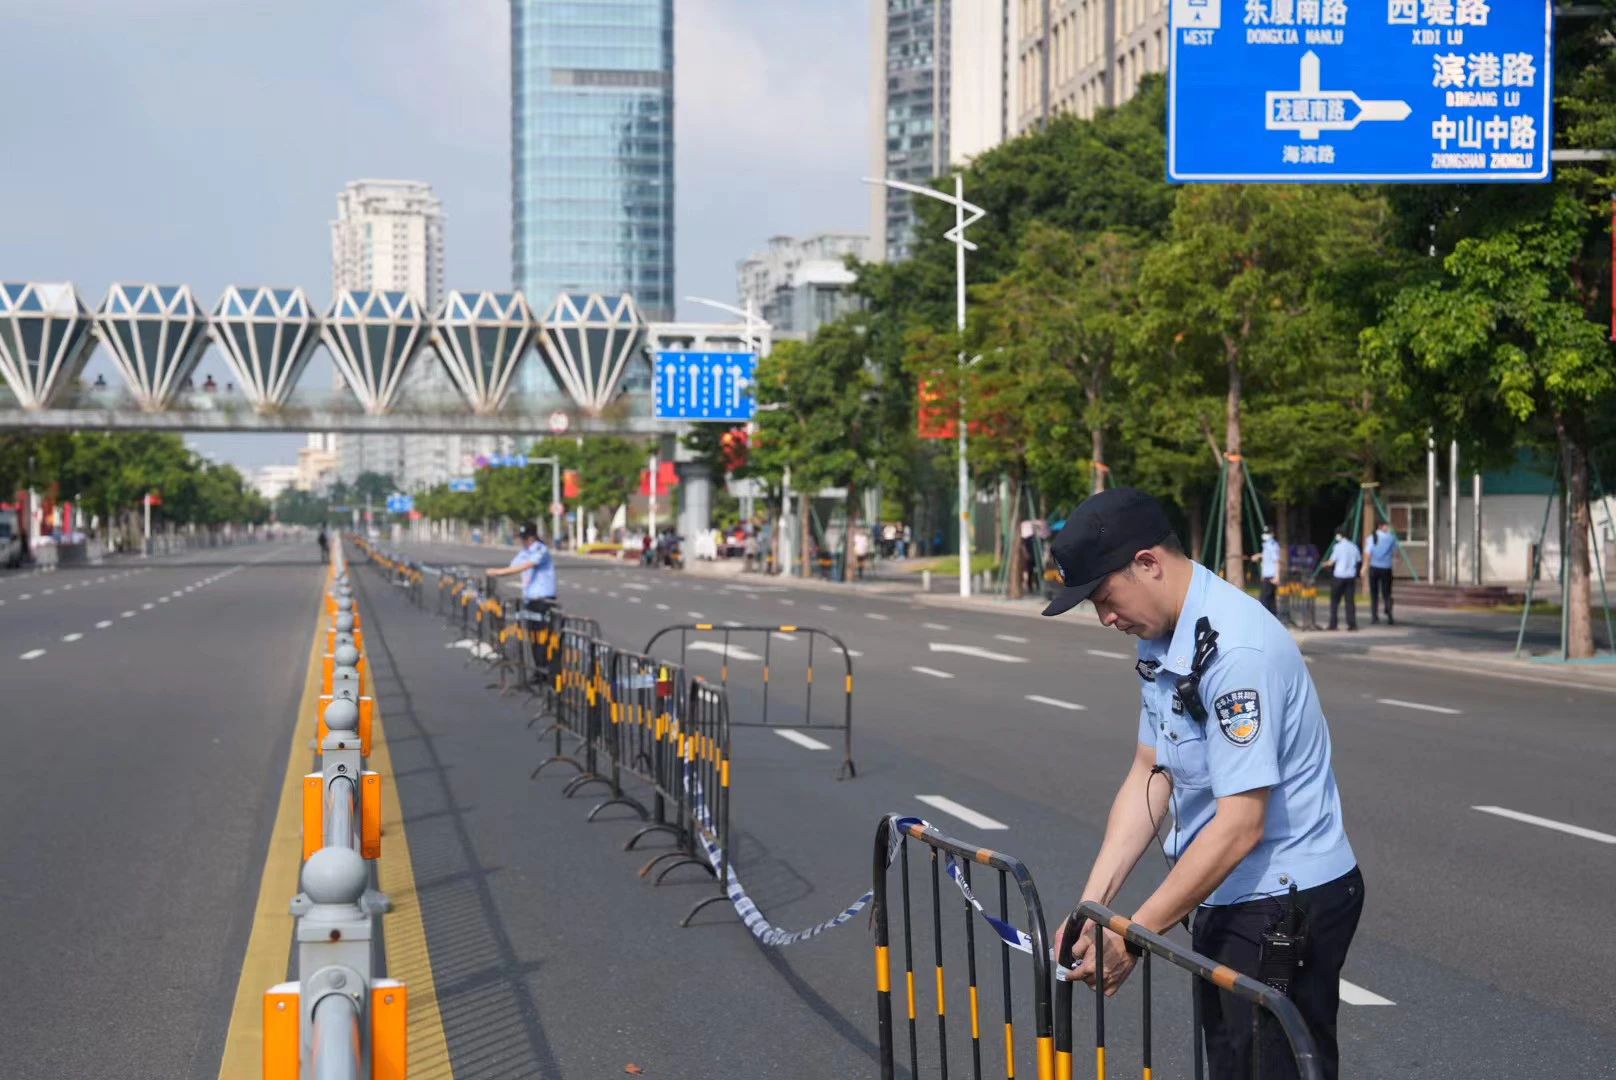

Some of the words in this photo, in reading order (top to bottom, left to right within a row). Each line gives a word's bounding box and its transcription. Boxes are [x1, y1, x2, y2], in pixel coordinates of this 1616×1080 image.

[1243, 0, 1348, 26] 东厦南路
[1387, 0, 1490, 26] 西堤路
[1183, 29, 1215, 45] WEST
[1246, 28, 1299, 44] DONGXIA
[1412, 29, 1441, 45] XIDI
[1447, 29, 1464, 45] LU
[1432, 51, 1536, 88] 滨港路
[1445, 91, 1498, 107] BINGANG
[1504, 91, 1520, 107] LU
[1431, 114, 1536, 150] 中山中路
